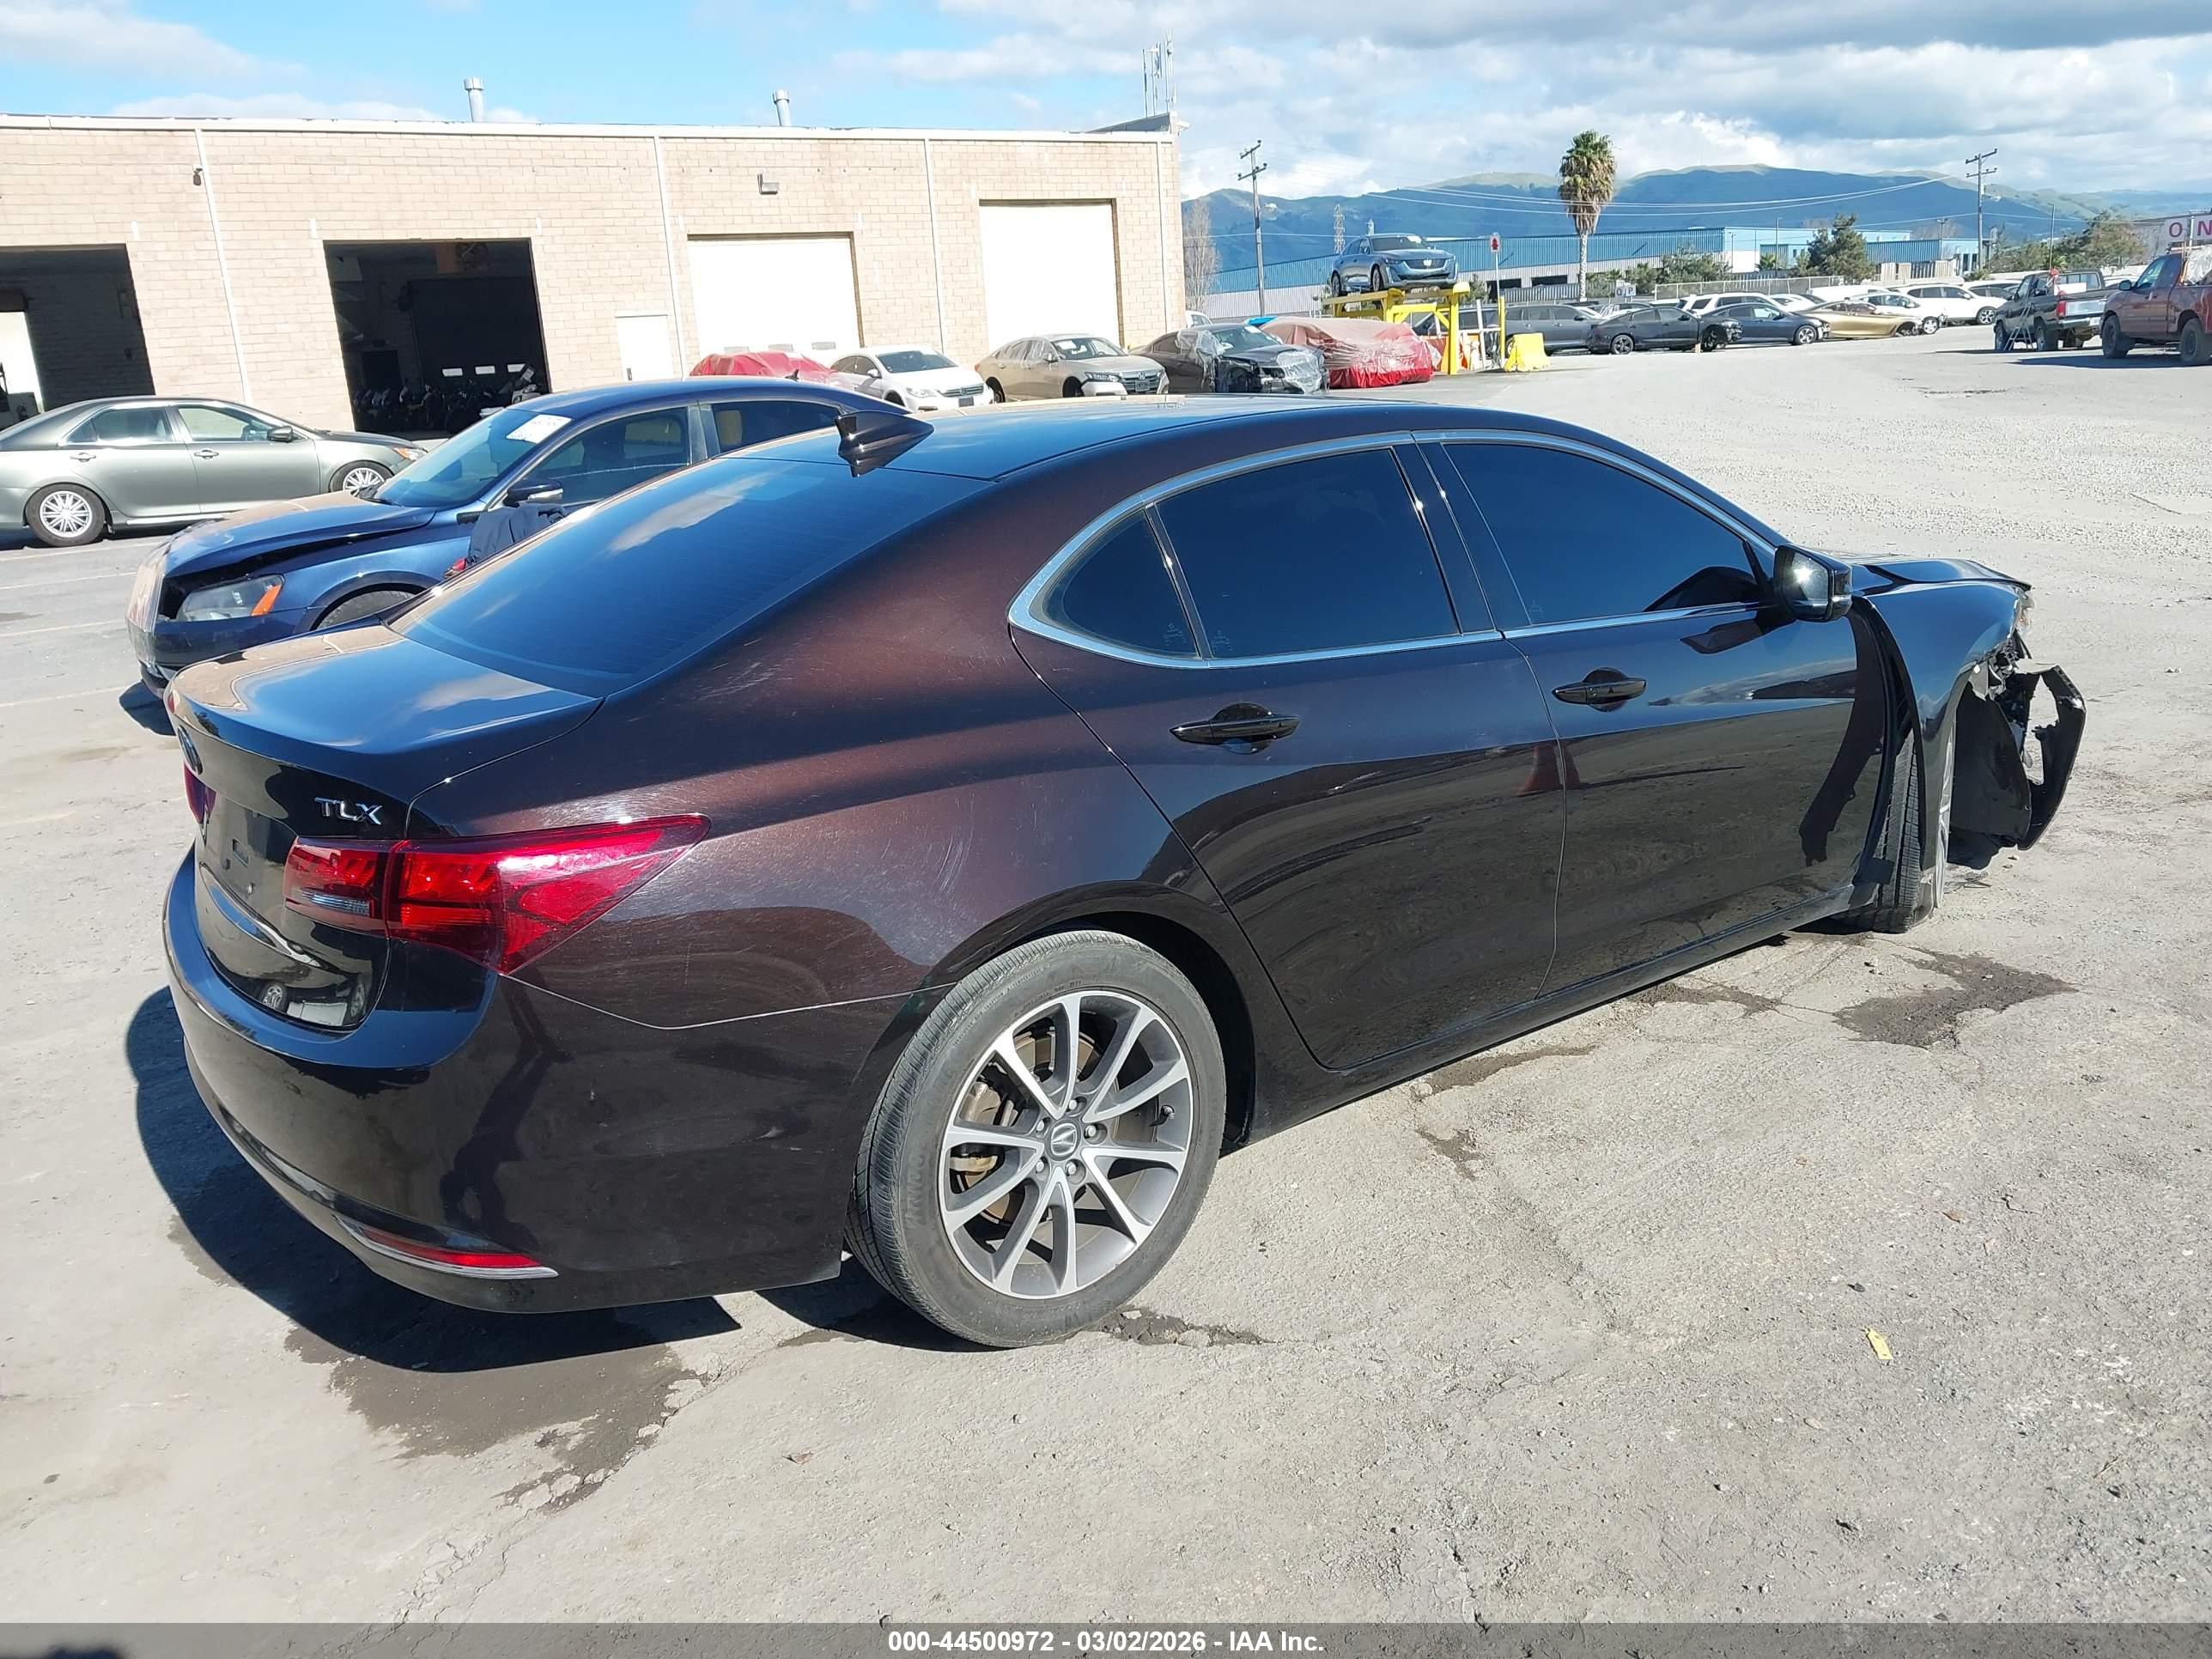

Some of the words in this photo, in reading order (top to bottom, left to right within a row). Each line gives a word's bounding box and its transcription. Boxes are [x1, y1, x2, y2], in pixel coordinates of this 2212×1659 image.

[2168, 222, 2183, 238] O
[2197, 219, 2212, 236] N
[314, 797, 382, 824] TLX
